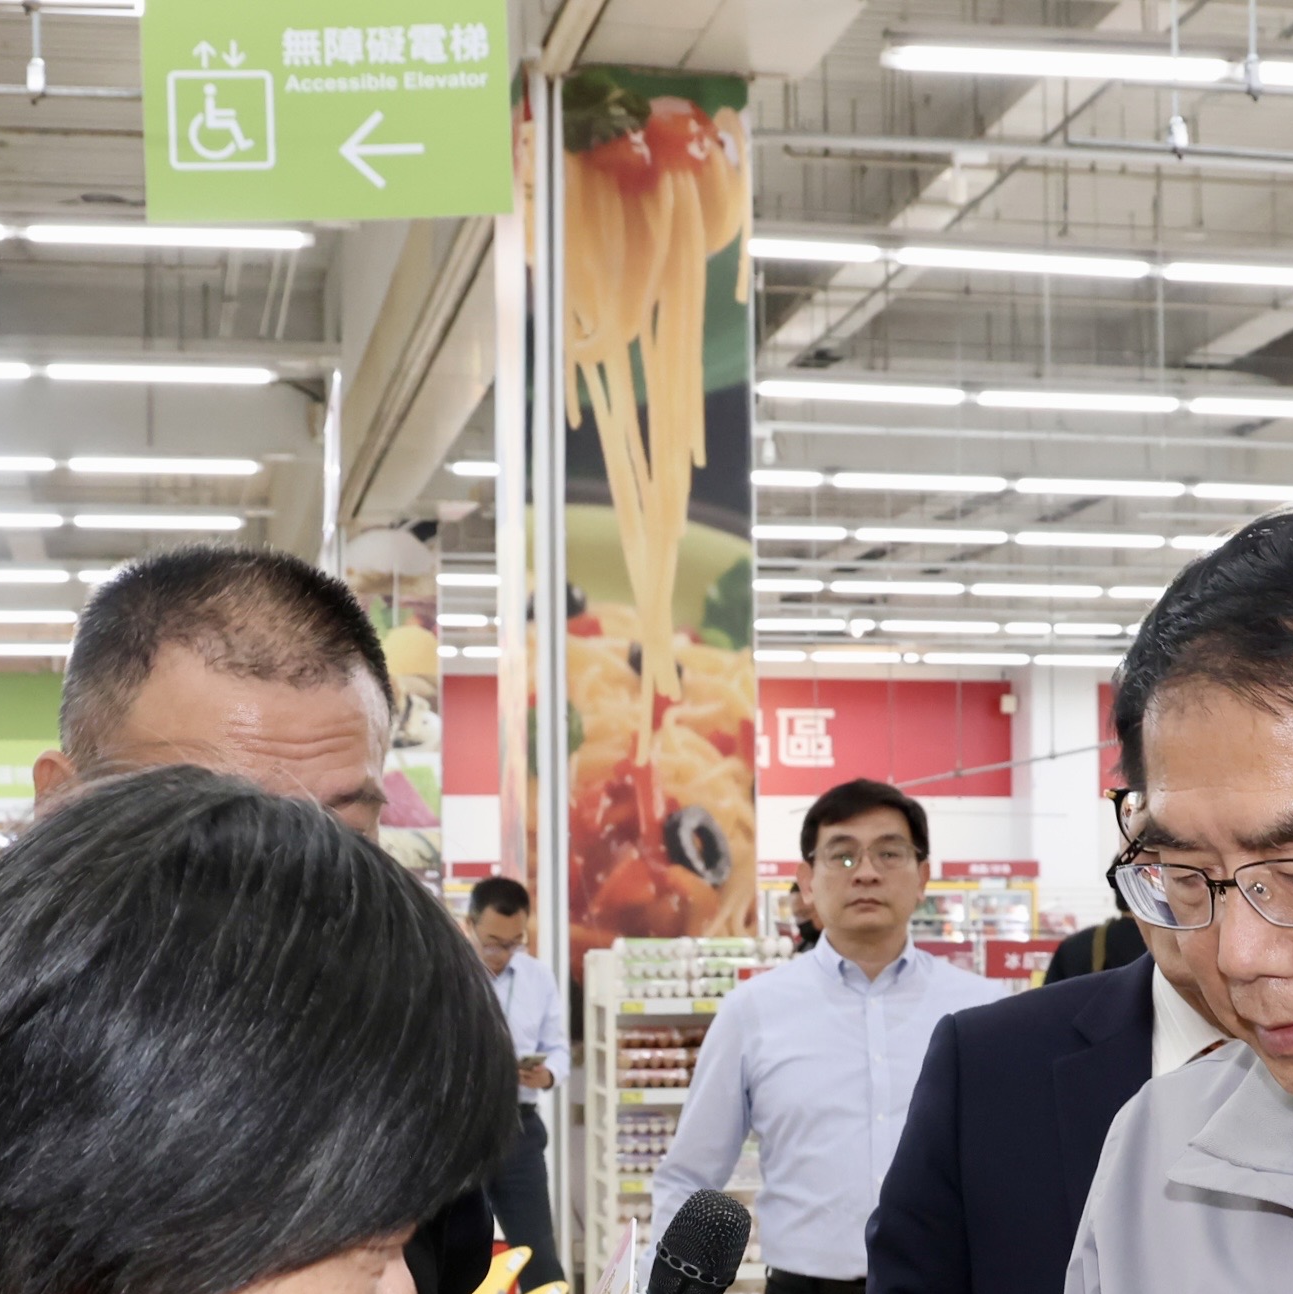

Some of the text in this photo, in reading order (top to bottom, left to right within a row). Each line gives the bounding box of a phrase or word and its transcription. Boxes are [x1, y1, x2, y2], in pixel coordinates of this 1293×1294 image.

[281, 23, 490, 68] 無障礙電梯
[285, 71, 488, 94] Accessible Elevator
